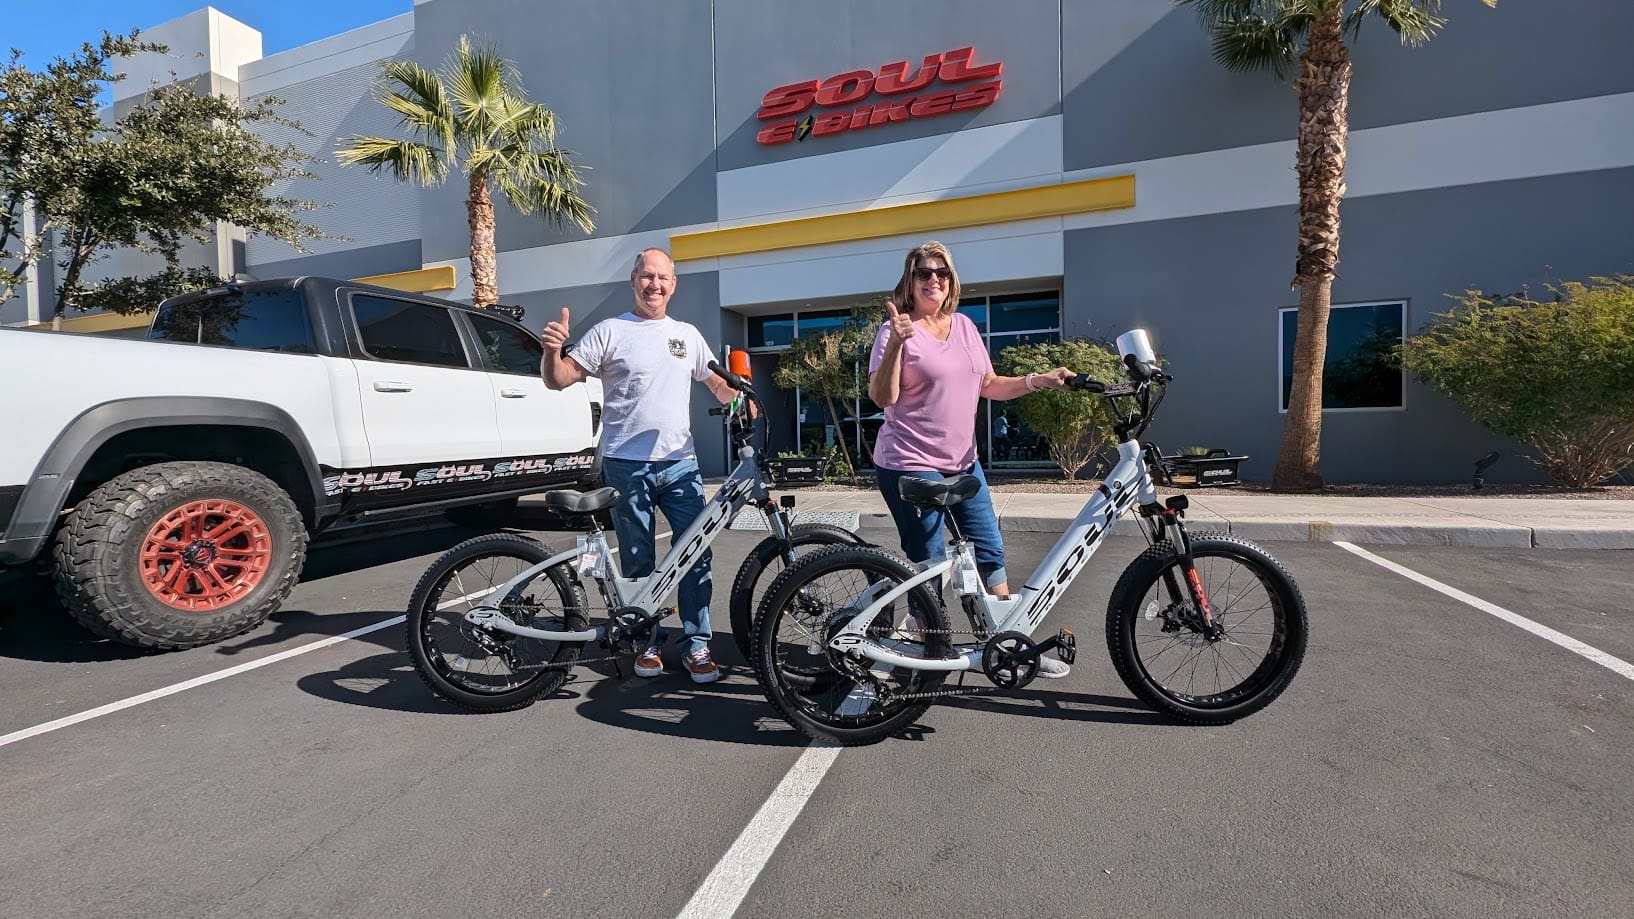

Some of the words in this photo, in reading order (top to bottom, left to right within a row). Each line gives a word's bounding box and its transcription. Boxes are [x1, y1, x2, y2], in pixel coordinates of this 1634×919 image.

[757, 46, 1002, 120] SOUL
[323, 471, 413, 492] SOUL
[413, 464, 492, 481] SOUL
[492, 459, 552, 474] SOUL
[1027, 475, 1154, 627] SOUL
